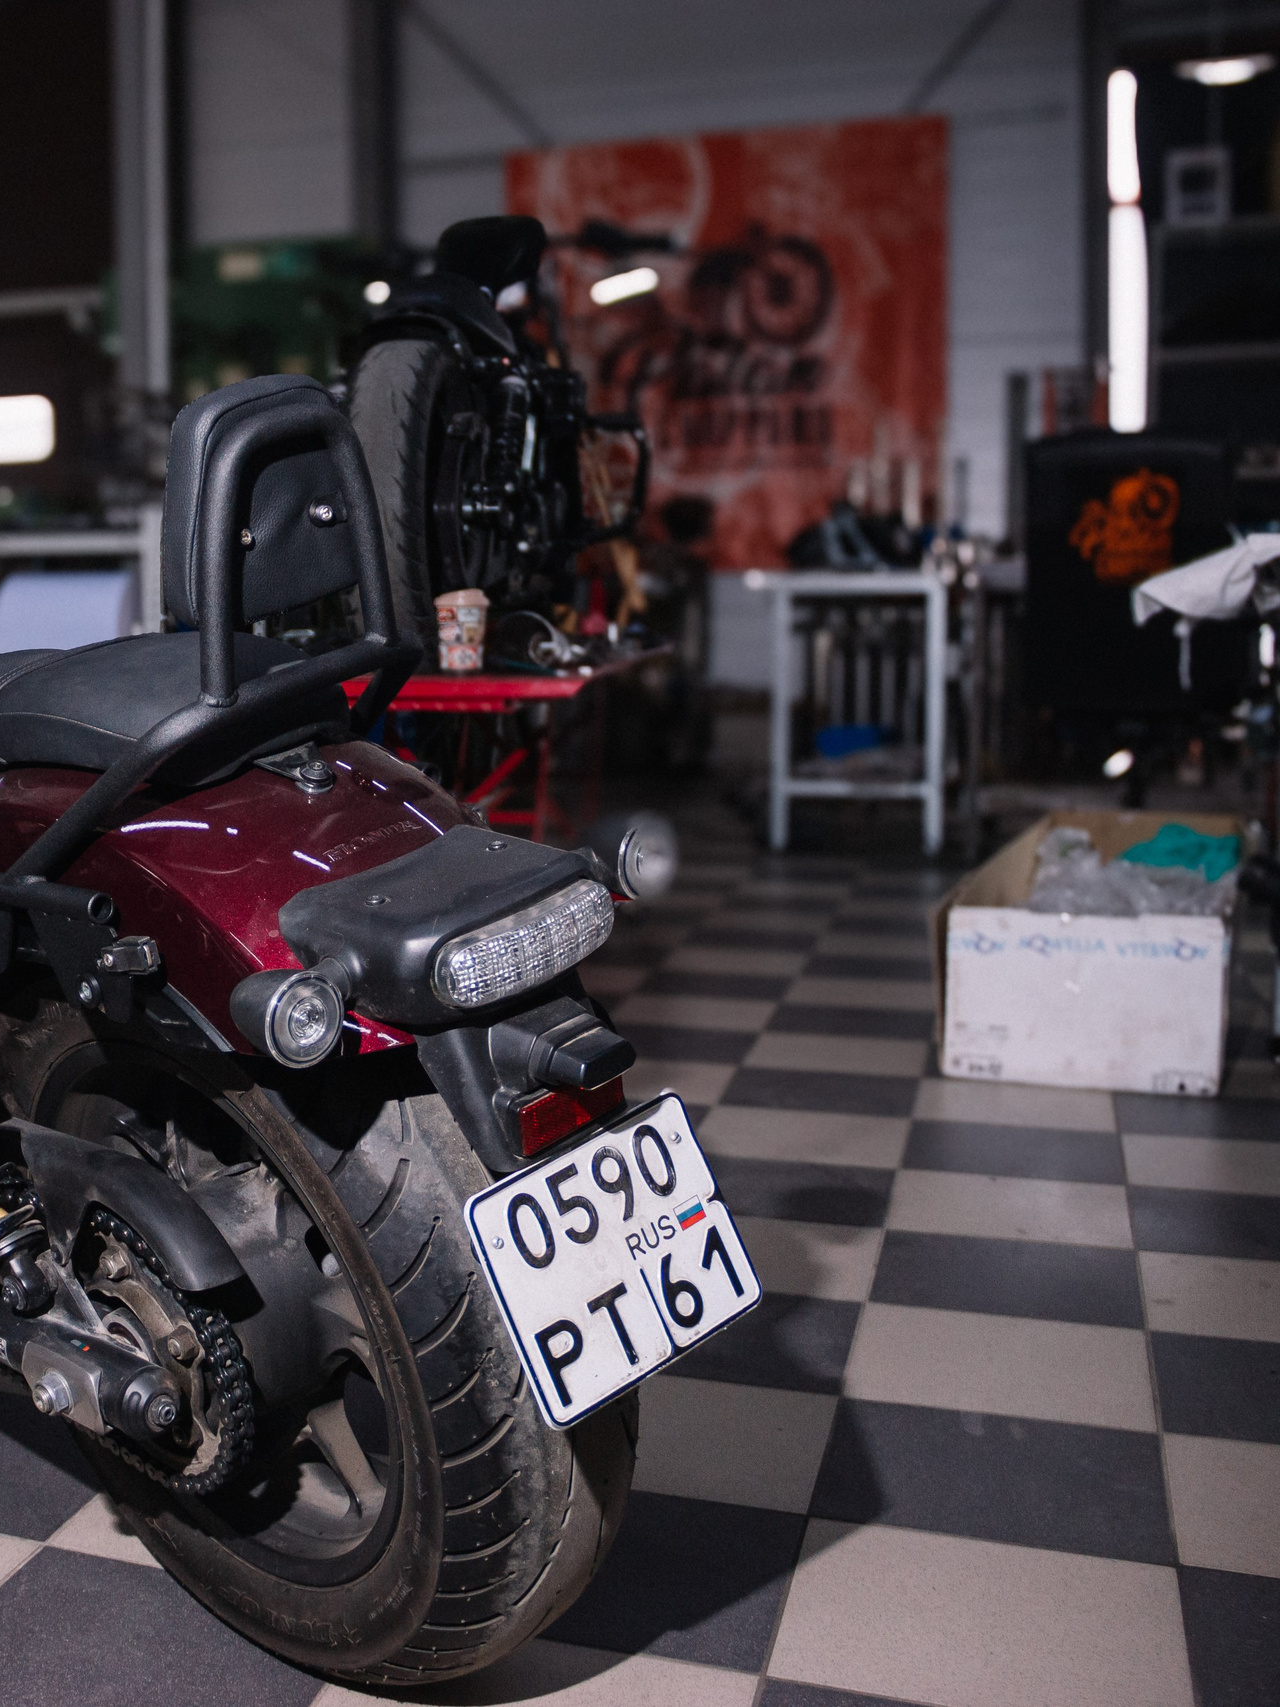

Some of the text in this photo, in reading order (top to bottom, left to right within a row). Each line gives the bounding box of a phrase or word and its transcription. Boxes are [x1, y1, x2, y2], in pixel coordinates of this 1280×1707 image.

[507, 1124, 677, 1269] 0590
[625, 1215, 677, 1260] RUS
[659, 1225, 745, 1329] 61
